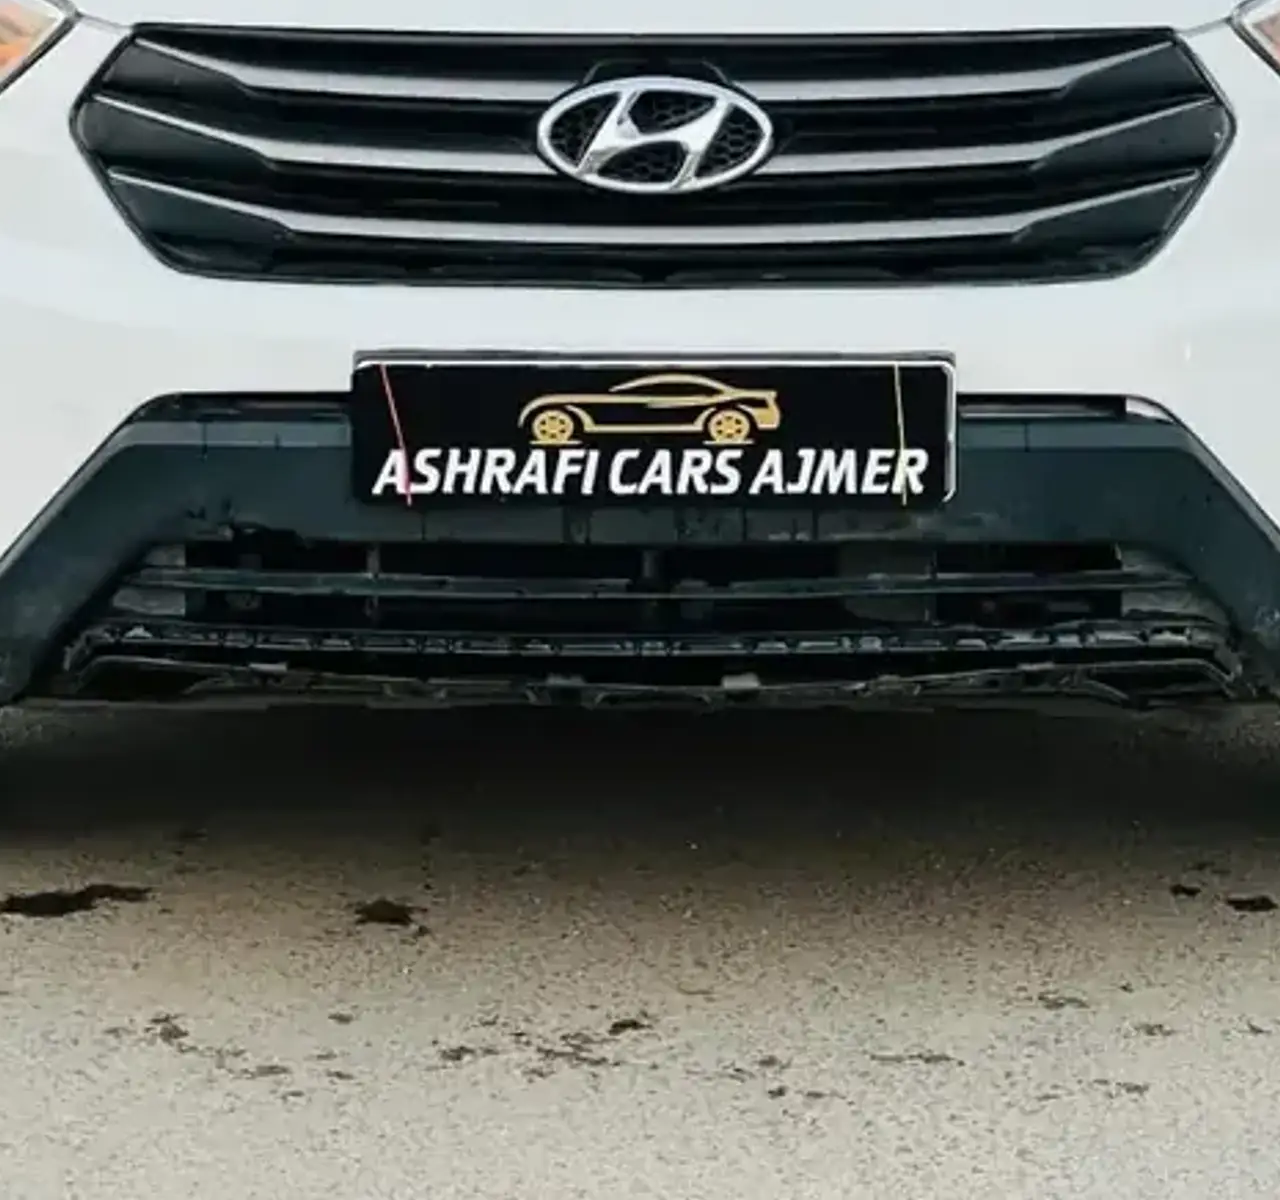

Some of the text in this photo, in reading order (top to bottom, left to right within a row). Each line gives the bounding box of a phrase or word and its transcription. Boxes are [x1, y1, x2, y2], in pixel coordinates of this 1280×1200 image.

[371, 448, 929, 495] ASHRAFI CARS AJMER
